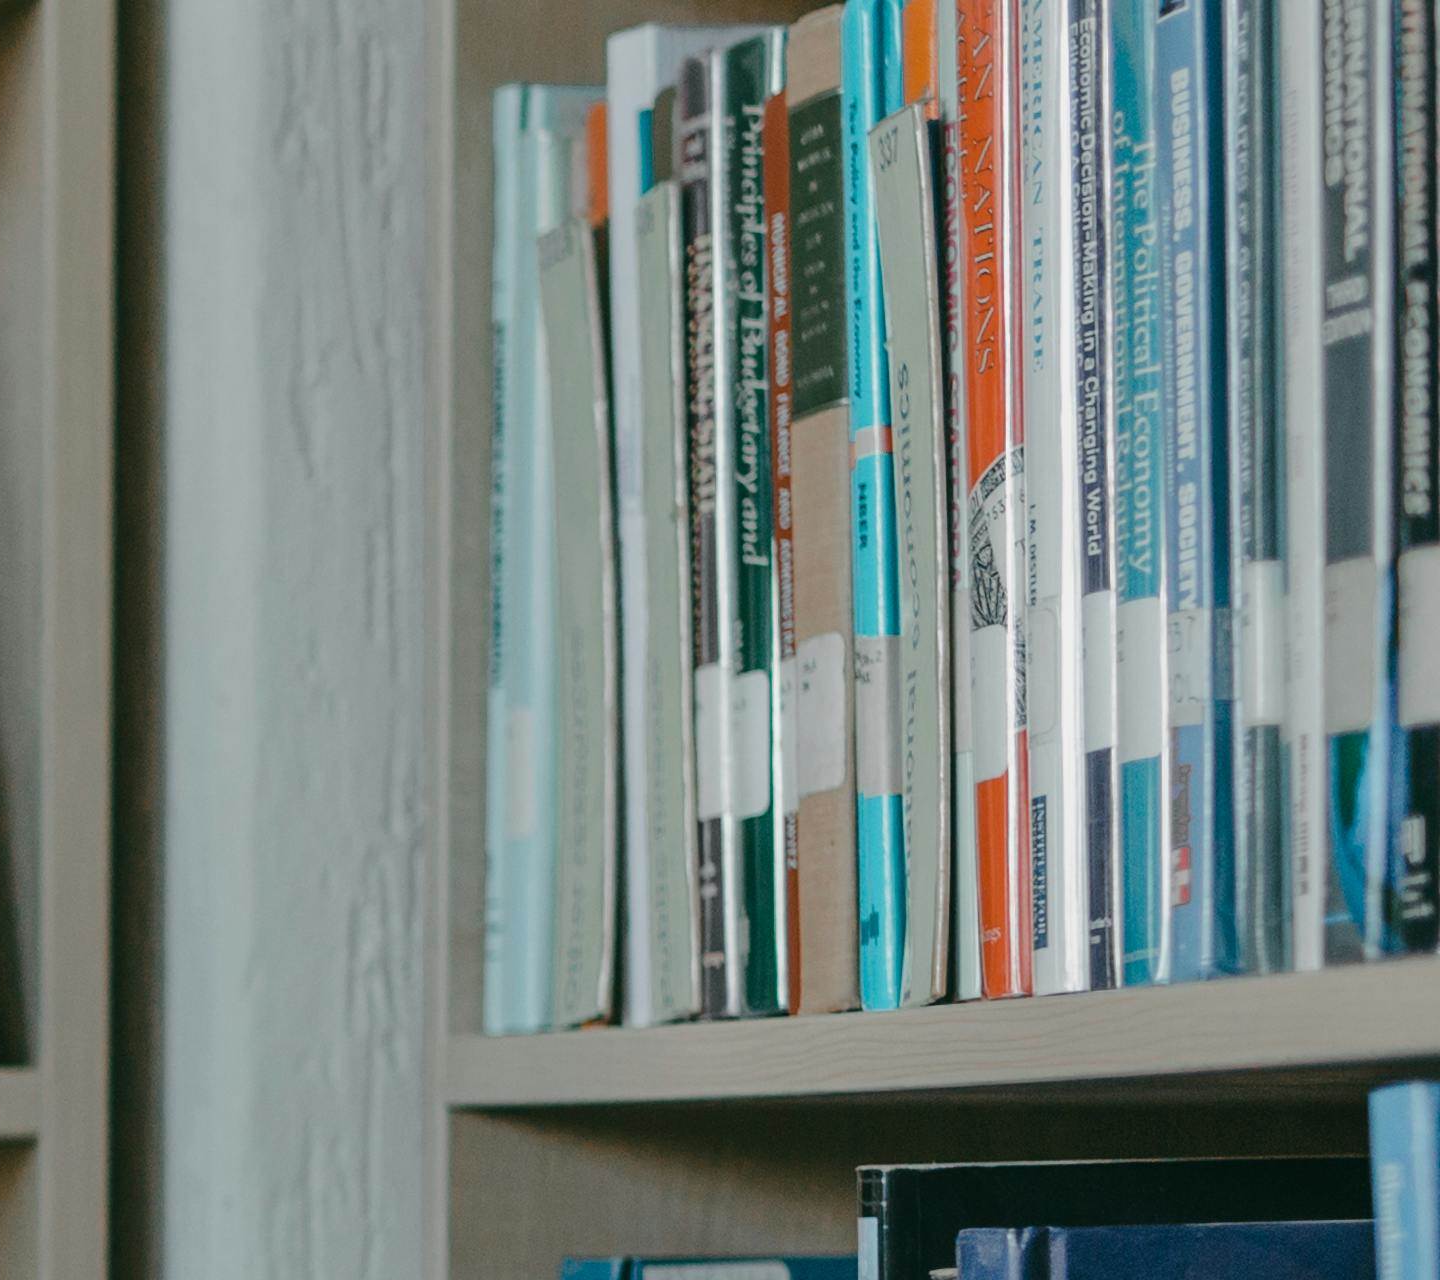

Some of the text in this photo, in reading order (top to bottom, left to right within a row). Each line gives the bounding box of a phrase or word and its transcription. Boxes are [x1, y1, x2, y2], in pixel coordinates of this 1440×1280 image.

[735, 104, 769, 567] Principles of Budgetary and
[1032, 230, 1045, 374] TRADE
[1079, 20, 1101, 560] Economic Decision-Making Changing World
[1129, 140, 1162, 581] The Political Economy
[1403, 282, 1430, 515] ECONOMICS
[1178, 482, 1198, 609] SOCIETY
